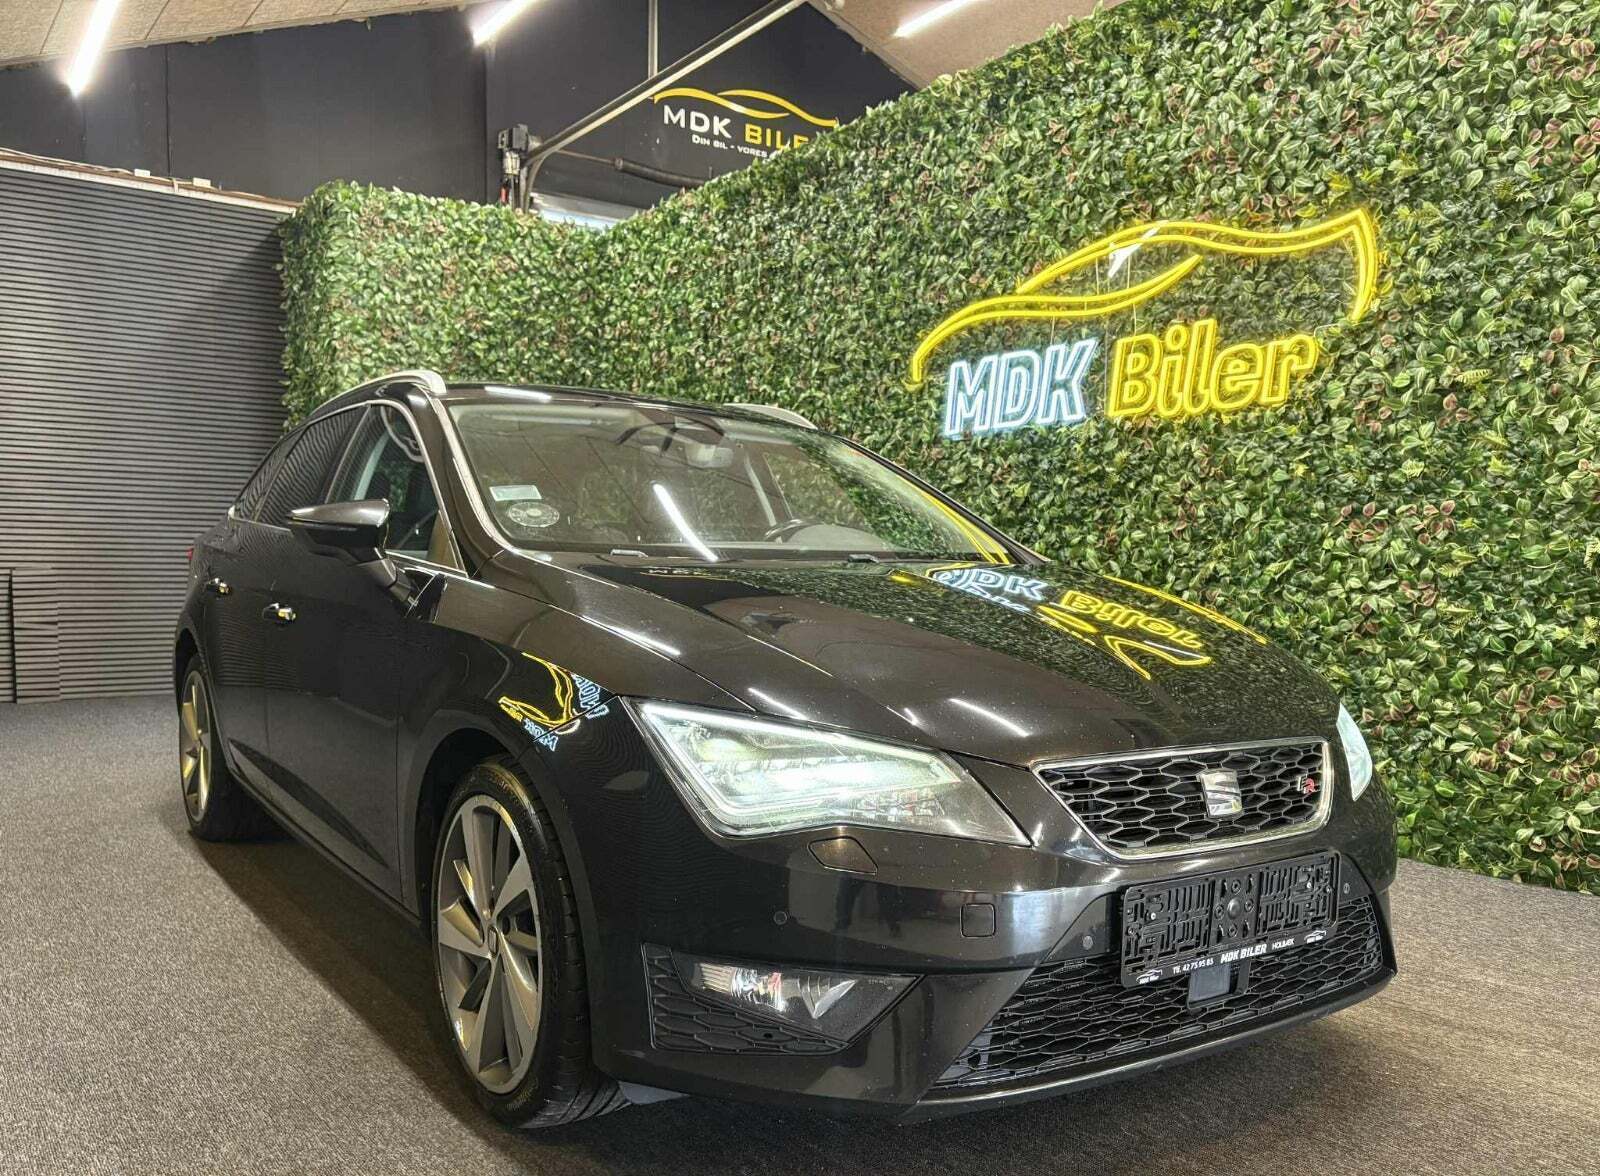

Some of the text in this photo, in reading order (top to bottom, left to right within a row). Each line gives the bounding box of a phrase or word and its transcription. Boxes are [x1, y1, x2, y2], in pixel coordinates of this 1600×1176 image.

[663, 104, 809, 150] MDK BILE
[737, 145, 768, 157] VORES
[943, 318, 1321, 439] MDK Biler
[1220, 949, 1240, 964] MDK
[1240, 943, 1267, 959] BILER
